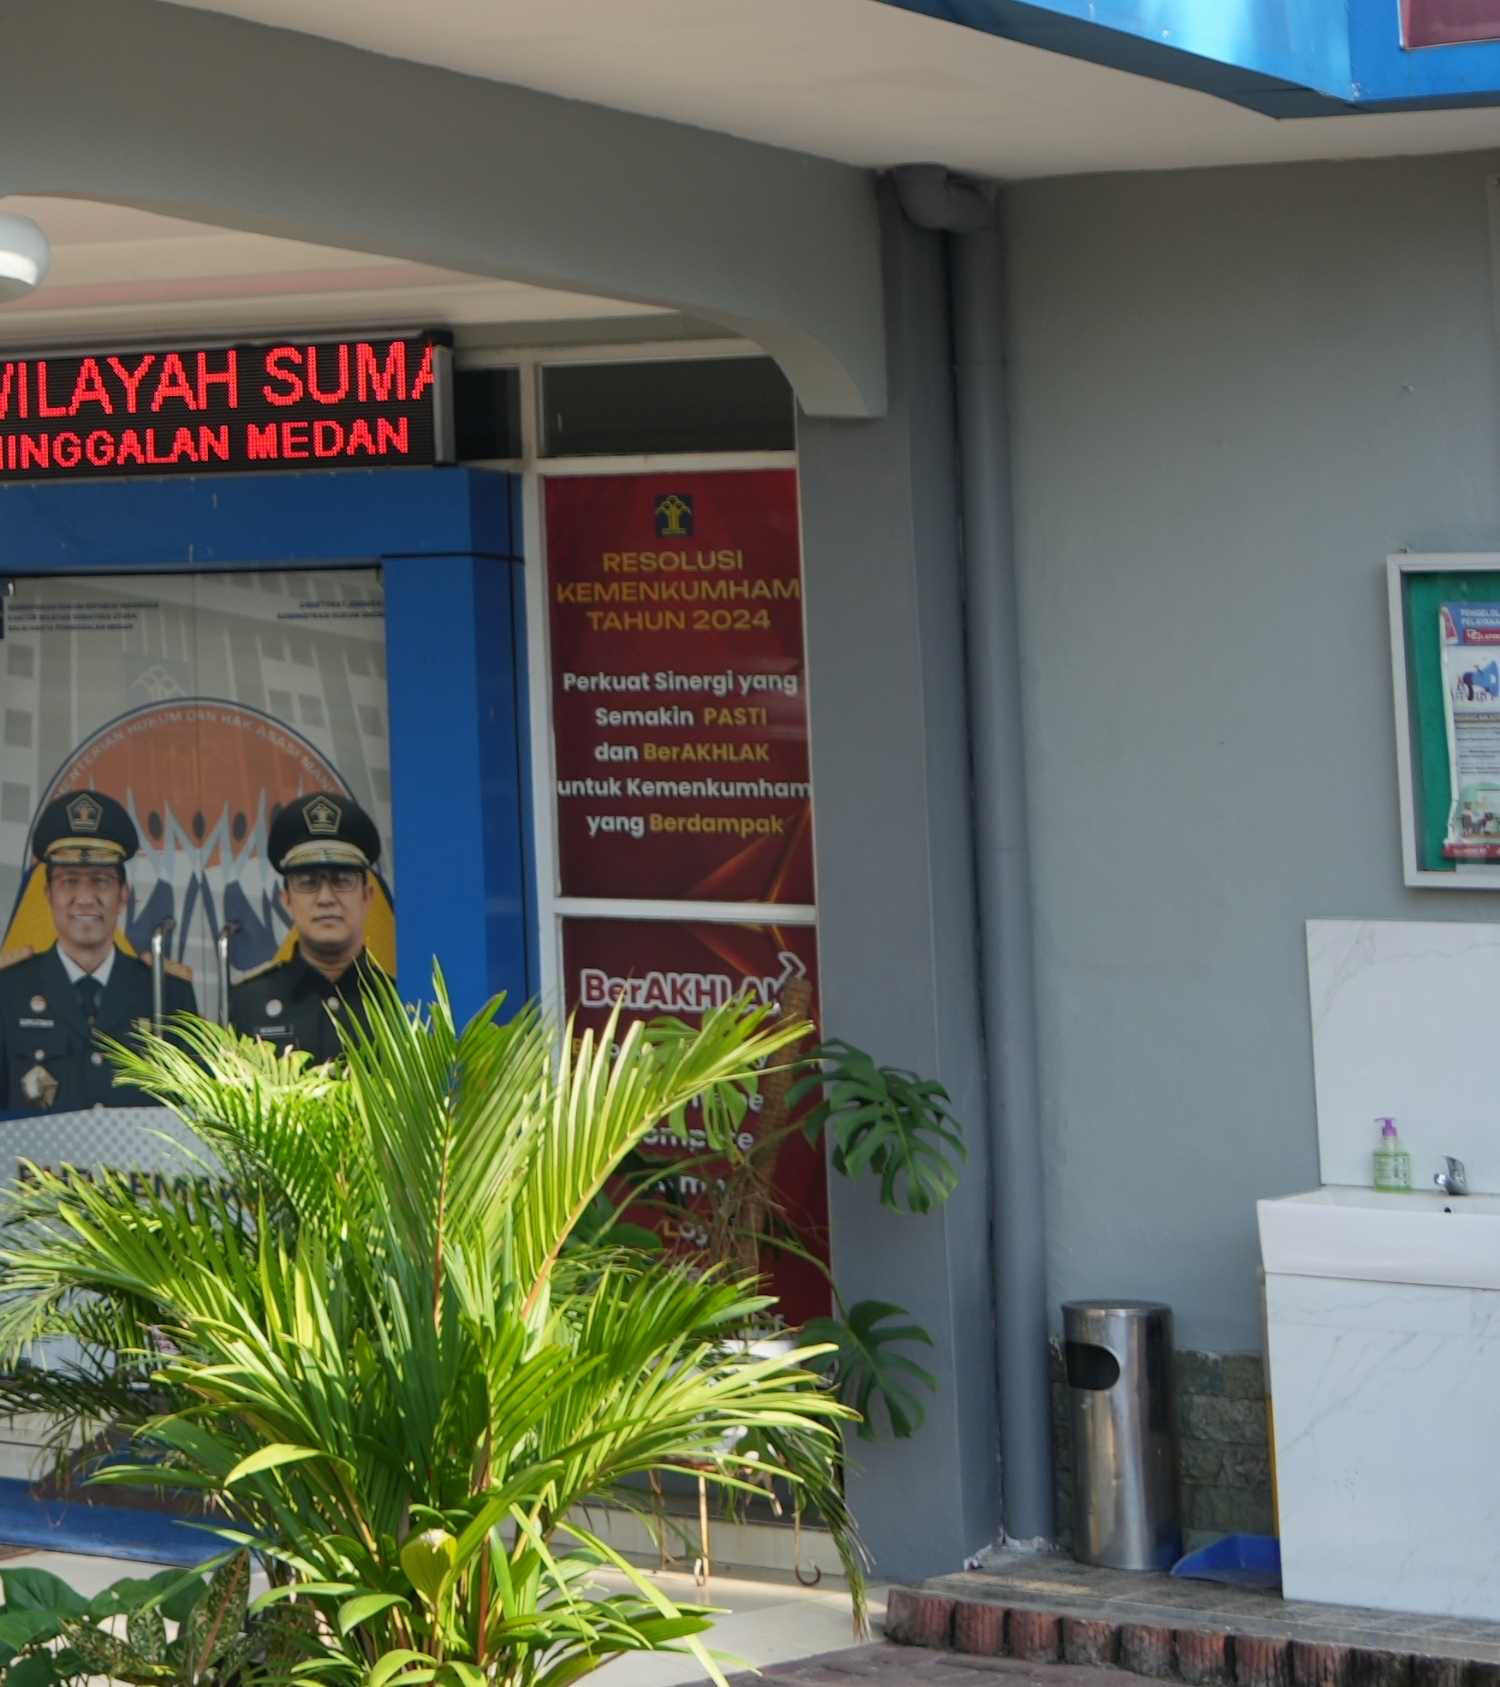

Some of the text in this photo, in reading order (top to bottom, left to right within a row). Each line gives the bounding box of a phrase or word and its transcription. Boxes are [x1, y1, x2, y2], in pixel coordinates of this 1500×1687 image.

[247, 417, 409, 460] MEDAN
[602, 550, 744, 574] RESOLUSI
[556, 578, 800, 605] KEMENKUMHAM
[586, 609, 772, 633] TAHUN 2024
[563, 670, 798, 697] Perkuat Sinergi yang
[595, 706, 768, 727] Semakin PASTI
[594, 742, 771, 763] dan BerAKHLAK
[557, 776, 811, 798] untuk Kemenkumham
[587, 813, 785, 839] yang Berdampak
